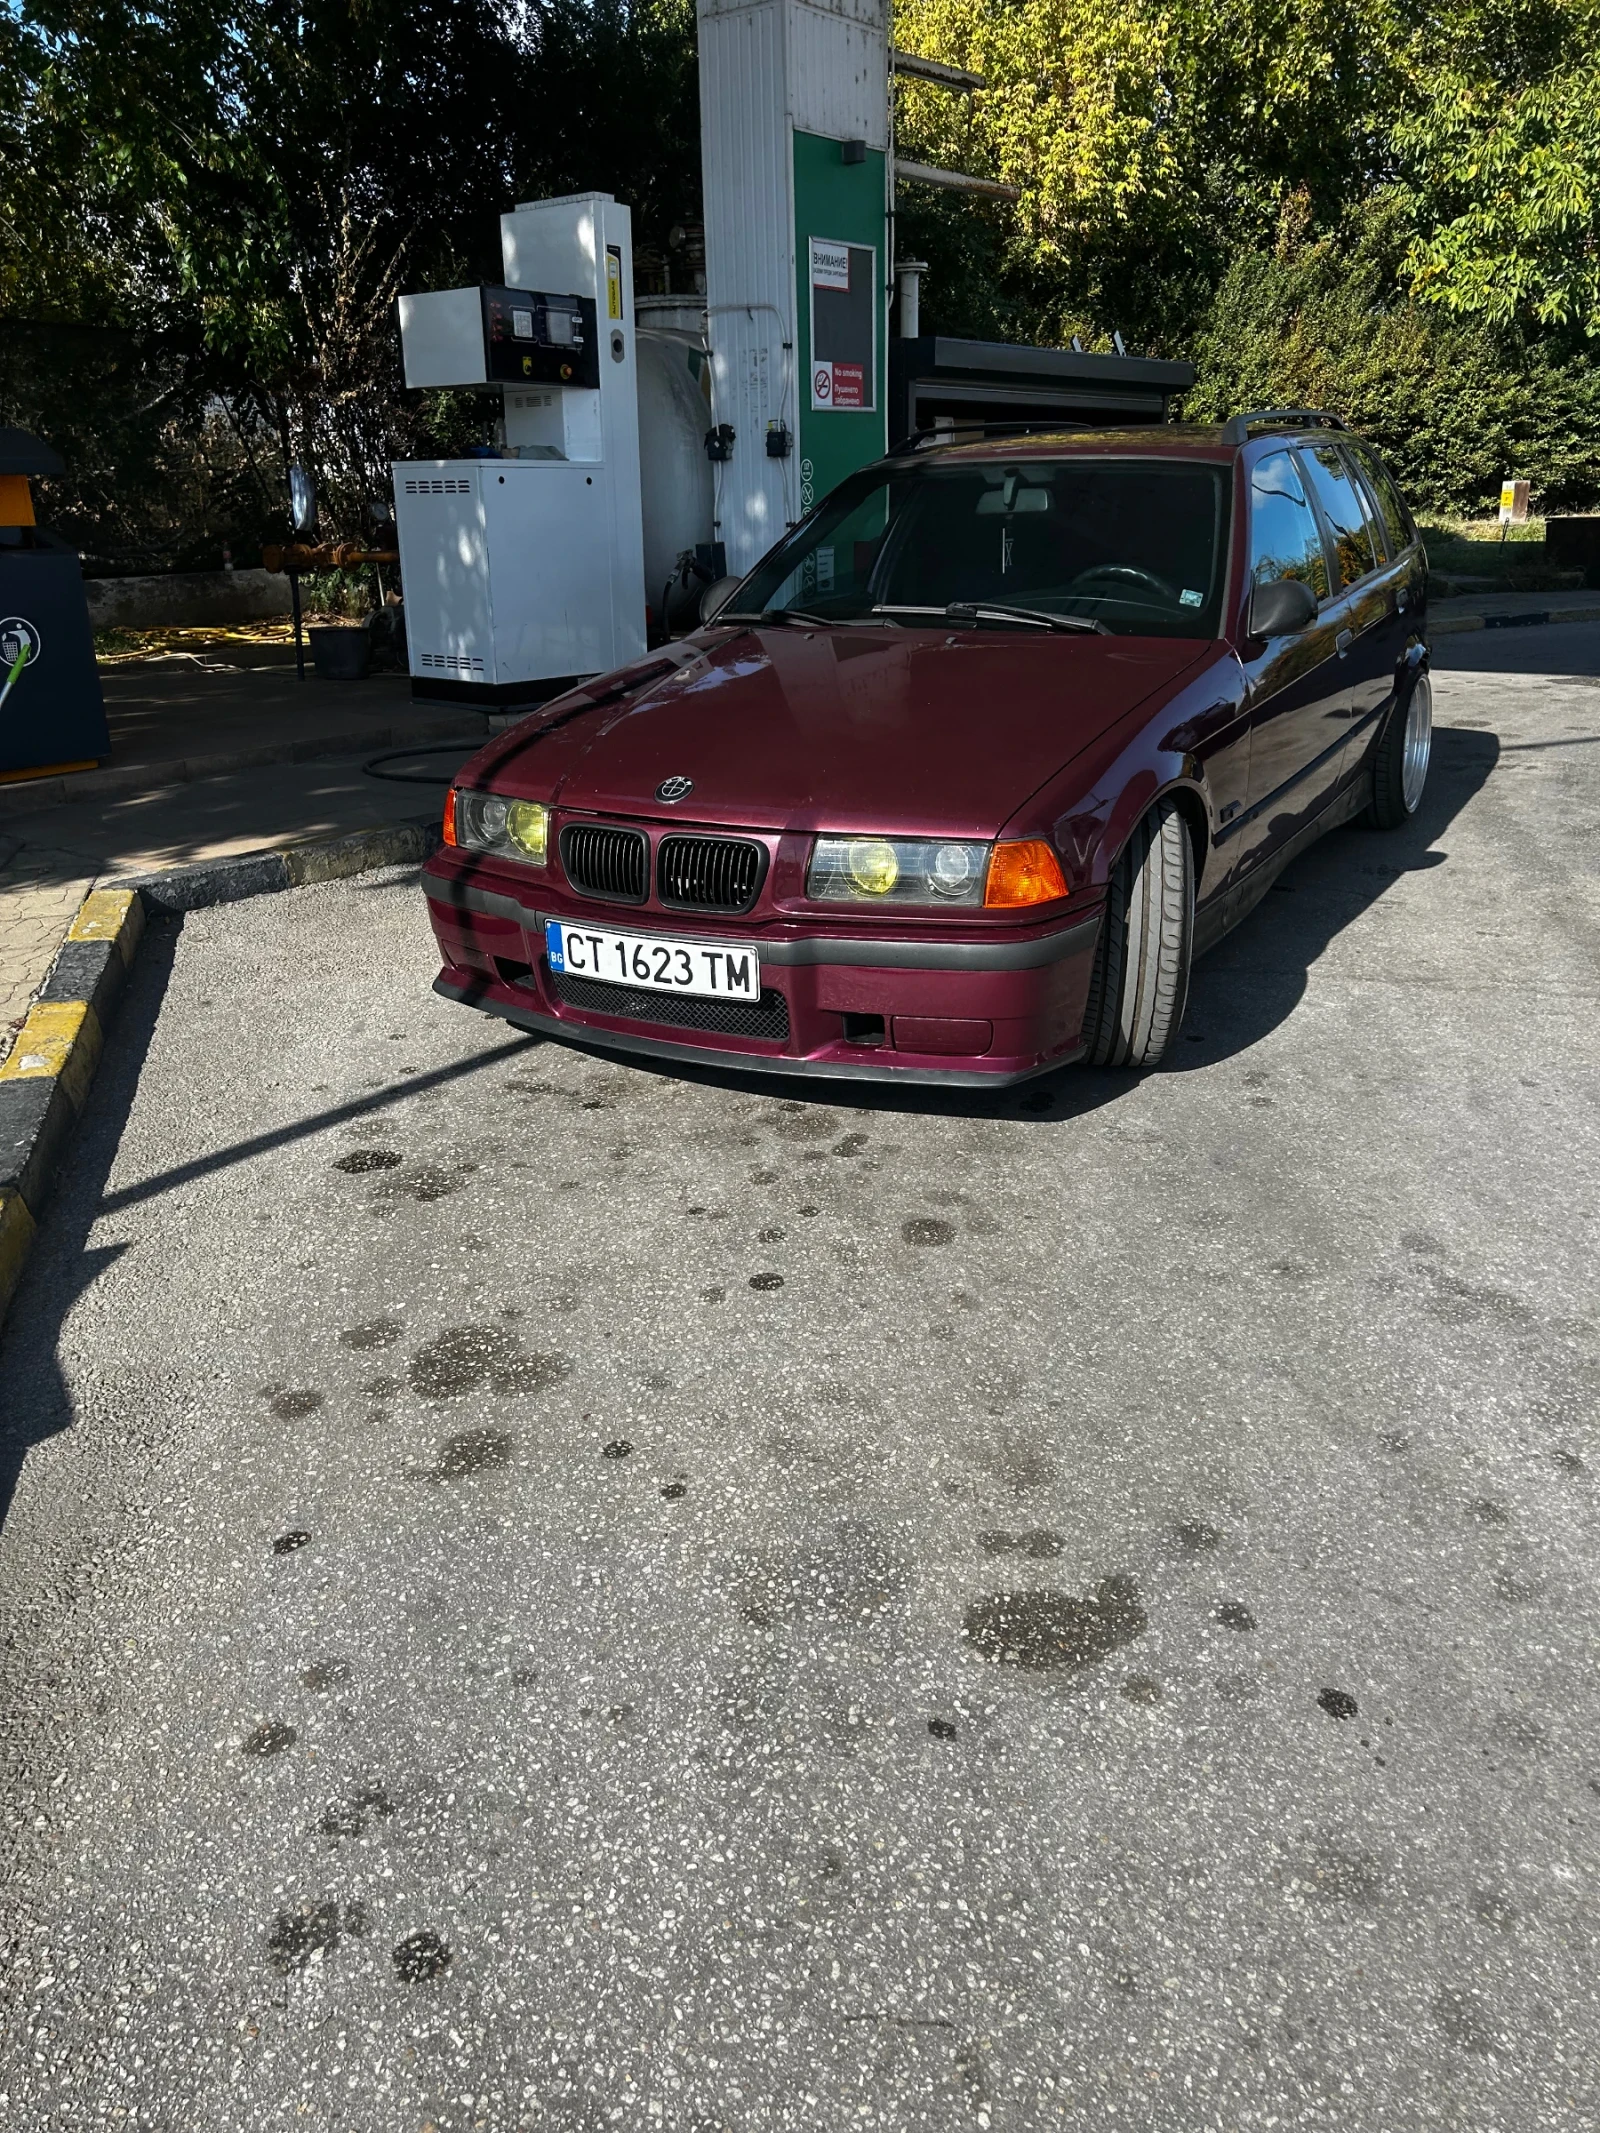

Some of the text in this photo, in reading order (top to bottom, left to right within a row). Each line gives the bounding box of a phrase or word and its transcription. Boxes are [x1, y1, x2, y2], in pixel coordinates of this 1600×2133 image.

[834, 367, 863, 380] No smoking
[834, 383, 859, 395] Пушенето
[834, 395, 860, 405] забранено
[550, 951, 564, 964] BG
[566, 932, 751, 993] CT 1623 TM
